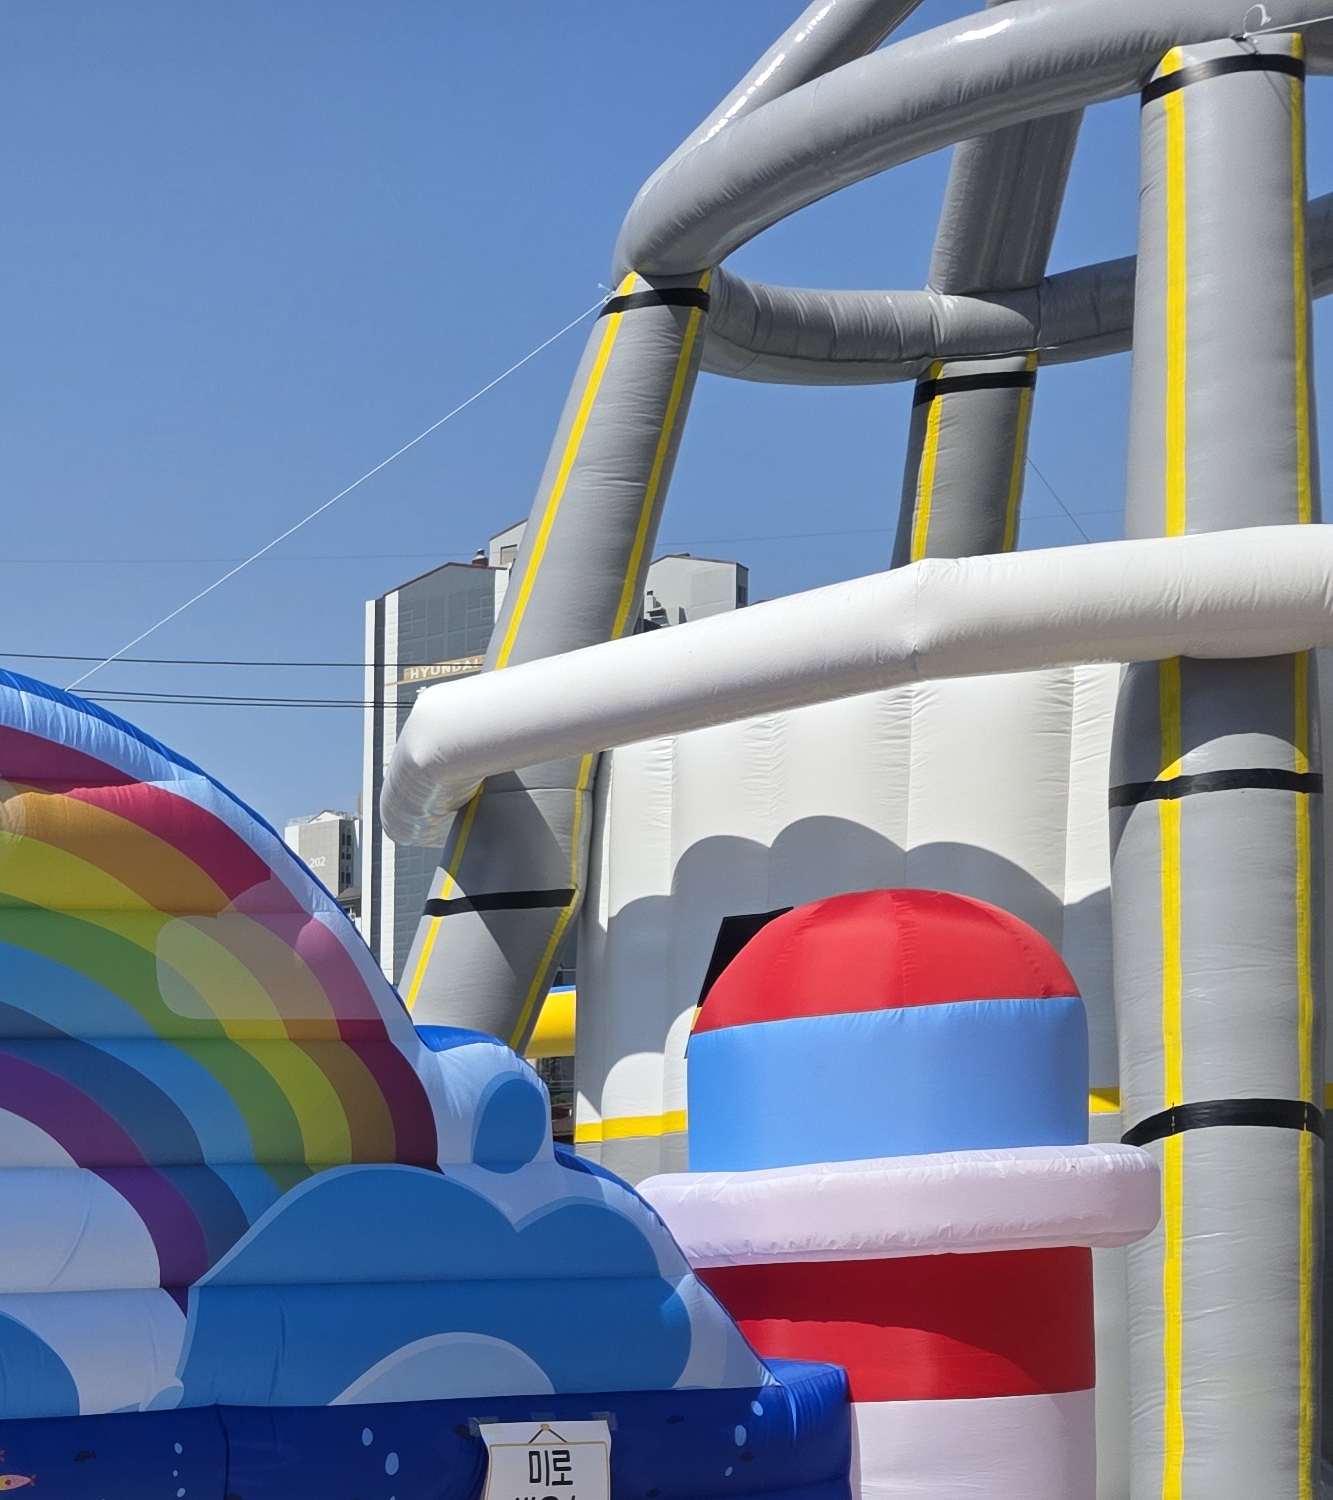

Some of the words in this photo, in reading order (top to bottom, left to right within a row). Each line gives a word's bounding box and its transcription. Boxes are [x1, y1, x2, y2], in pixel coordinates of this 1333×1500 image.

[410, 658, 480, 679] HYUNDAI
[309, 856, 326, 868] 202
[528, 1449, 574, 1487] 미로
